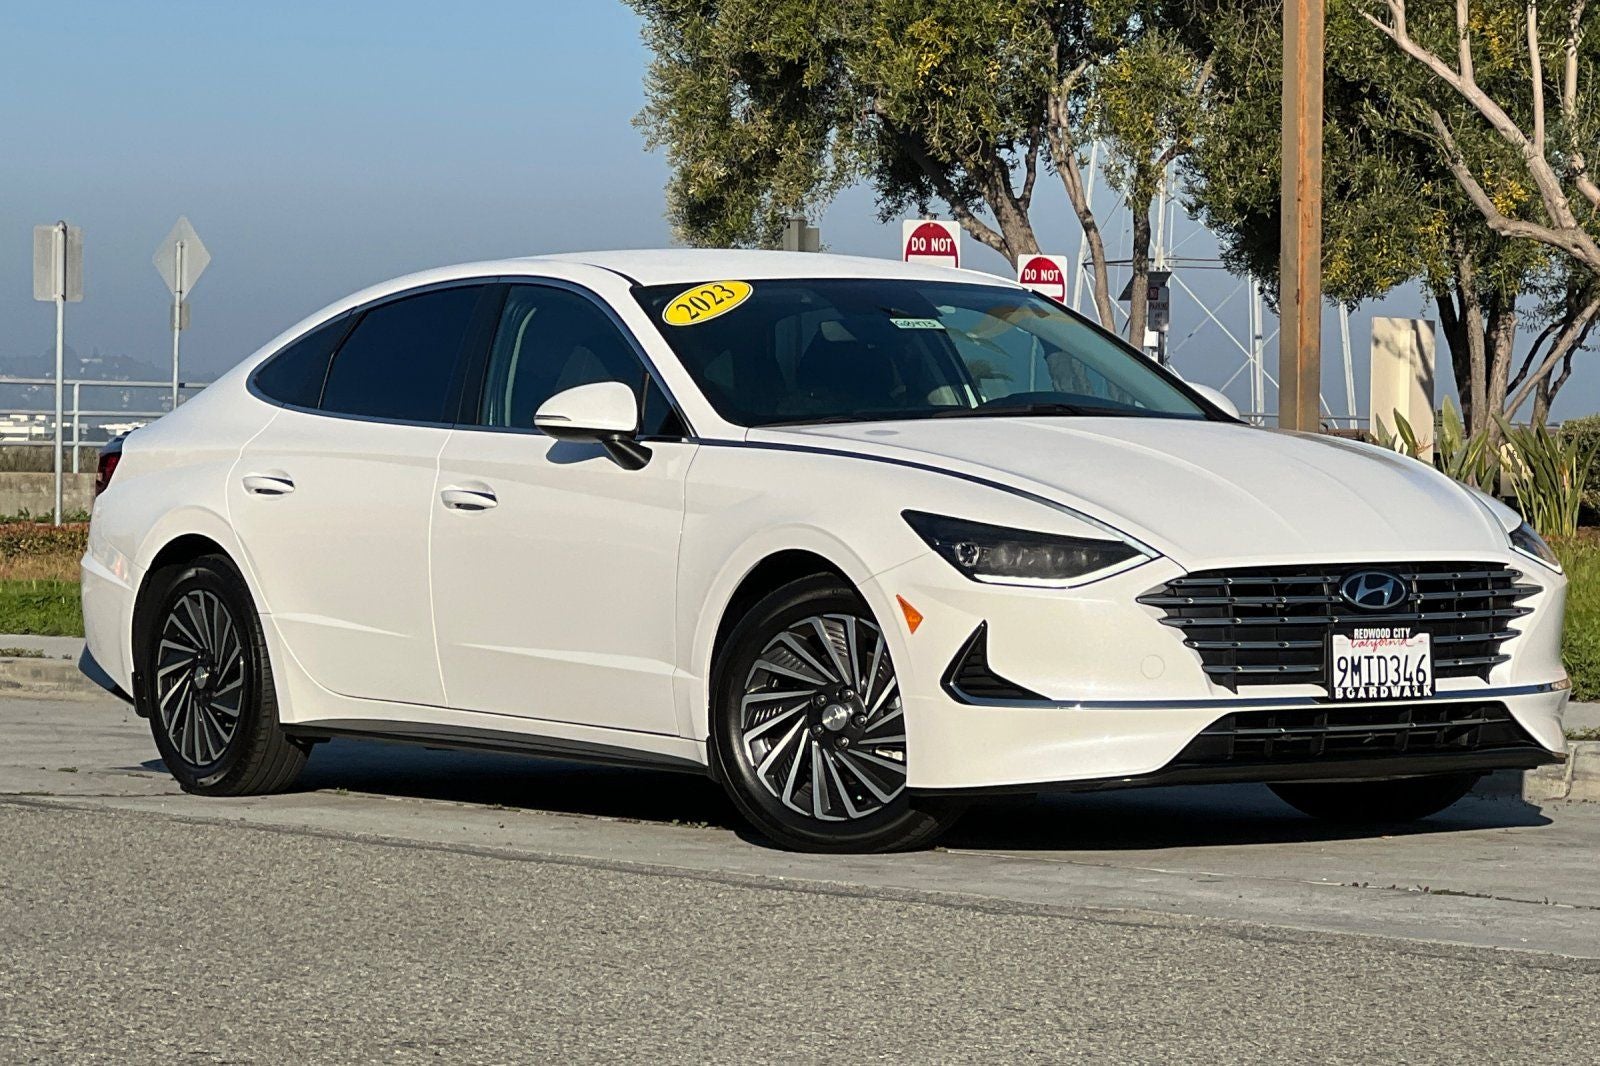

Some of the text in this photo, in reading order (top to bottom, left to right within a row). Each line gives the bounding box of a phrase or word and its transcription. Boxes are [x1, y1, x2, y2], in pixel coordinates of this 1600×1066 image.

[911, 237, 952, 252] DO NOT
[1024, 268, 1060, 282] DO NOT
[676, 285, 735, 320] 2023
[1354, 628, 1411, 639] REDWOOD CITY
[1337, 654, 1426, 687] 9MID346
[1335, 685, 1433, 699] BOARDWALK
